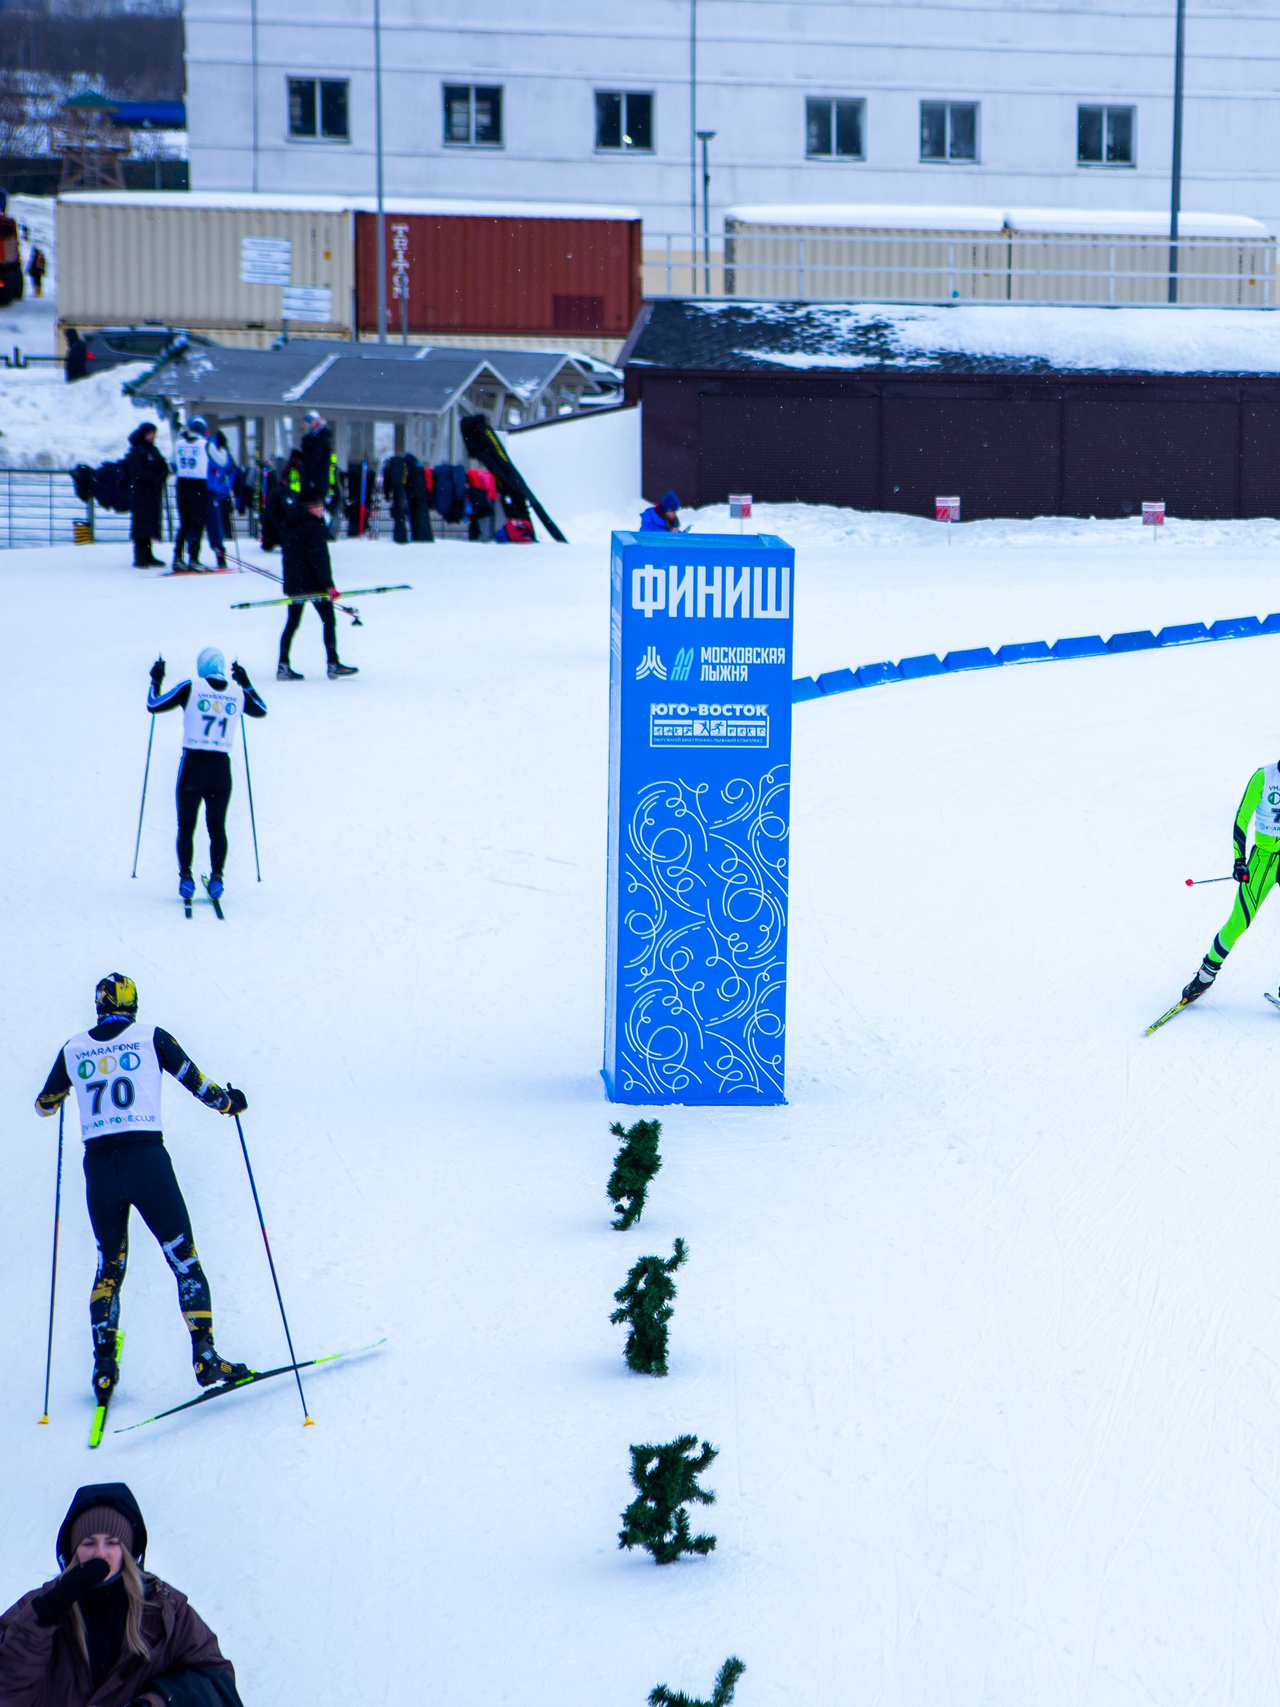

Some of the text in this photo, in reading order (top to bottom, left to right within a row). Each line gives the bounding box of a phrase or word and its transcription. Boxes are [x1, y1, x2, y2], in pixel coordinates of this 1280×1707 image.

[391, 223, 410, 300] TRITON
[632, 564, 790, 619] ФИНИШ
[701, 647, 786, 664] МОСКОВСКАЯ
[700, 665, 748, 682] ЛЫЖНЯ
[651, 703, 769, 717] ЮГО-ВОСТОК
[202, 715, 229, 738] 71
[75, 1042, 141, 1060] VMARAFONE
[86, 1076, 135, 1116] 70
